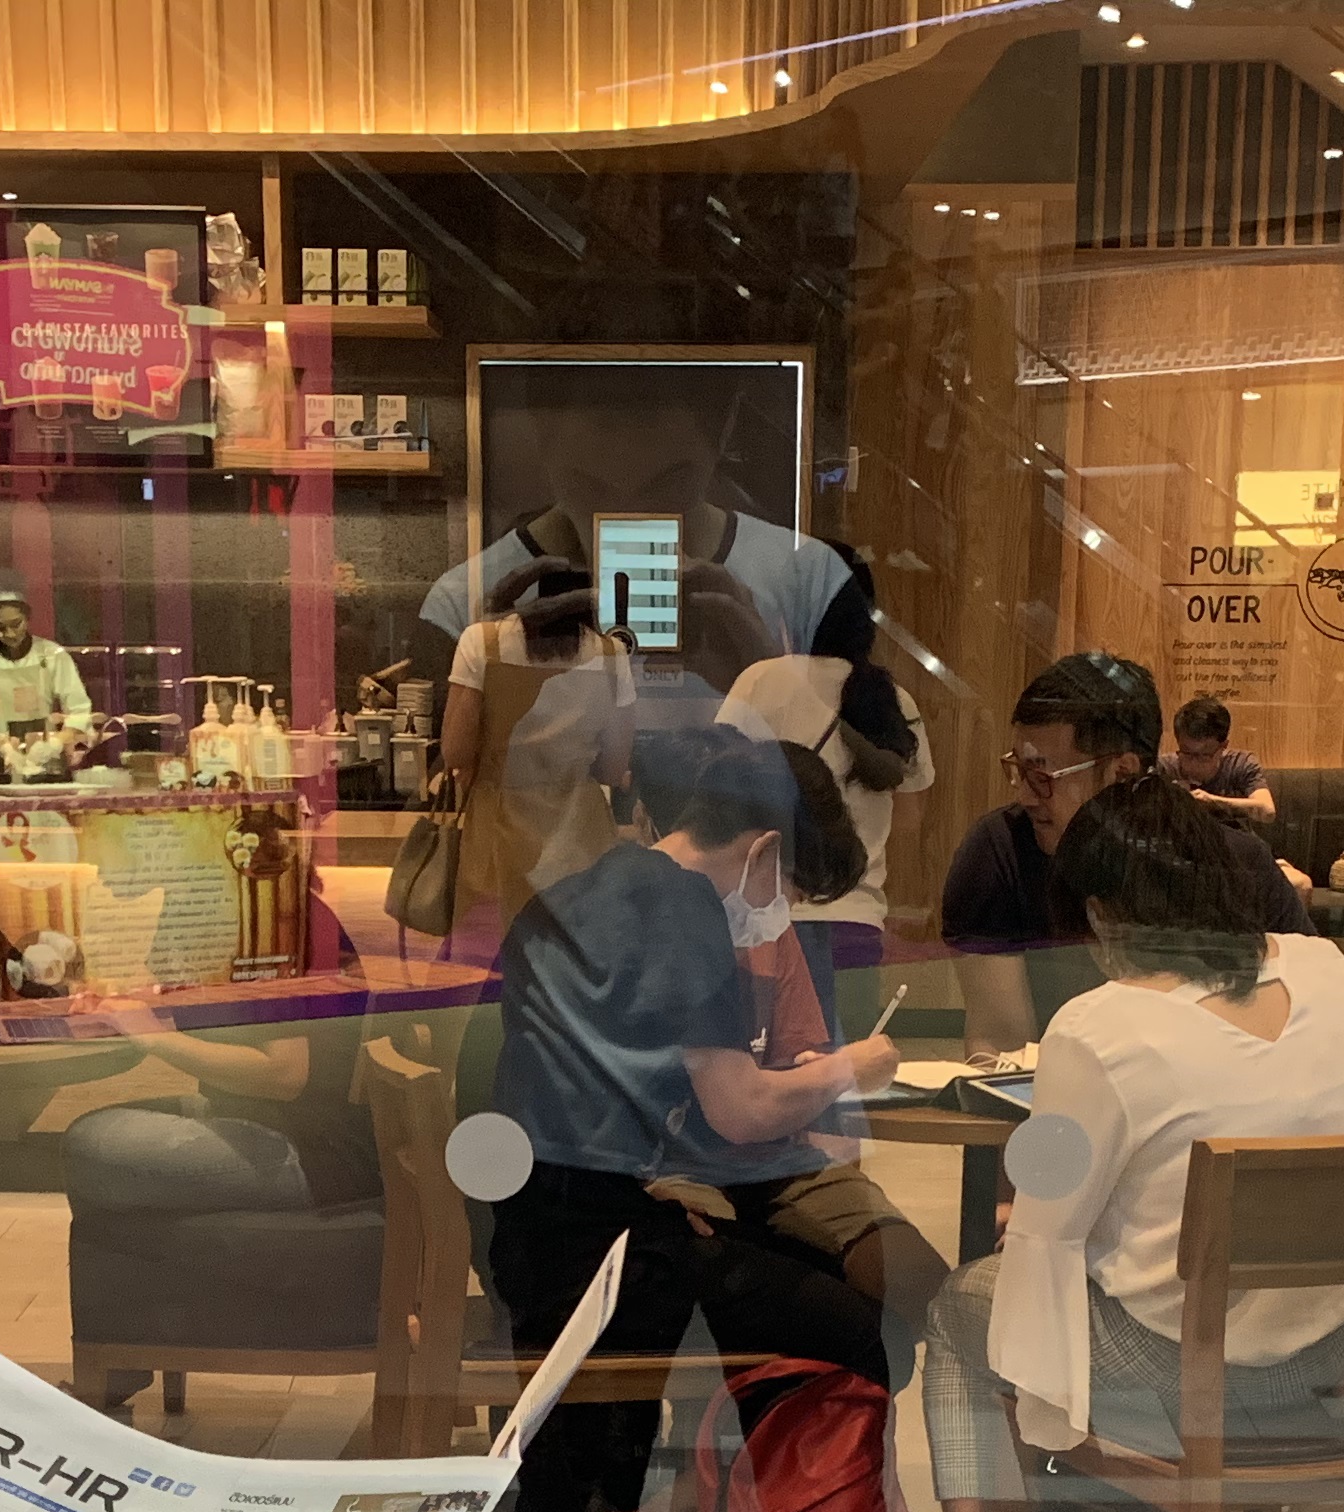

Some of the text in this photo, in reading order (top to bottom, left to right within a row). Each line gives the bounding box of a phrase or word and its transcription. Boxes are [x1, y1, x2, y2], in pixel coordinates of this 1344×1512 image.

[22, 322, 92, 338] BARISTA
[101, 322, 188, 340] FAVORITES
[1187, 595, 1260, 623] OVER
